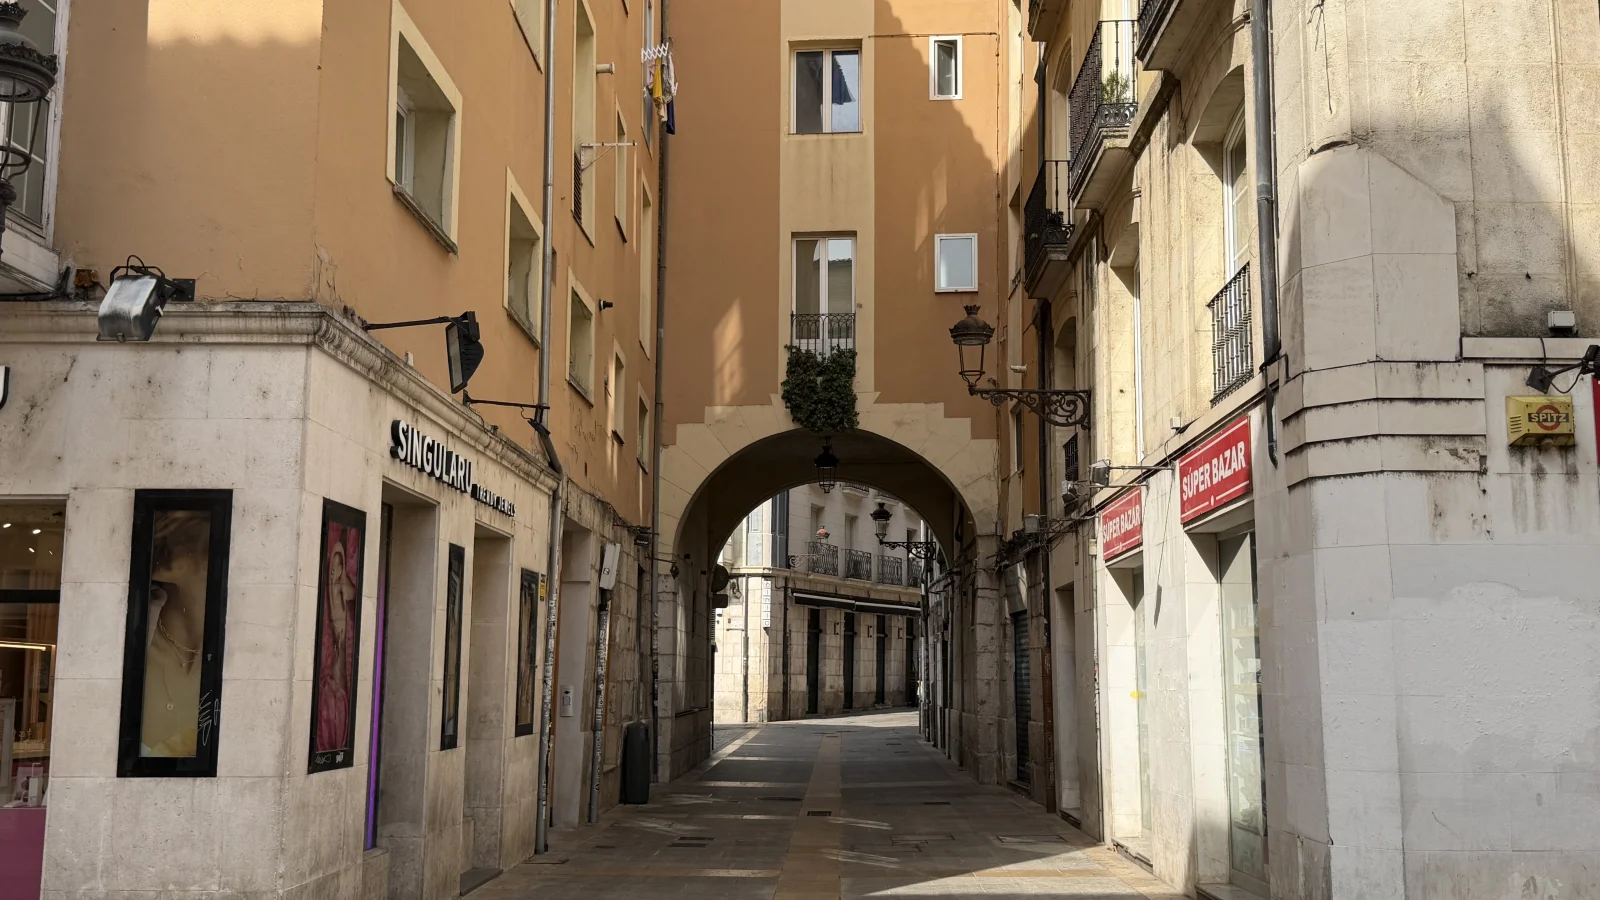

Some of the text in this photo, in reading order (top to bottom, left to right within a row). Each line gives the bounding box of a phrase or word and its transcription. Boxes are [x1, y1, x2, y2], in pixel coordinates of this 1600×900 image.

[1530, 413, 1567, 422] SPITZ
[393, 420, 474, 495] SINGULARU
[1182, 441, 1246, 501] SÚPER BAZAR
[1120, 504, 1141, 535] BAZAR
